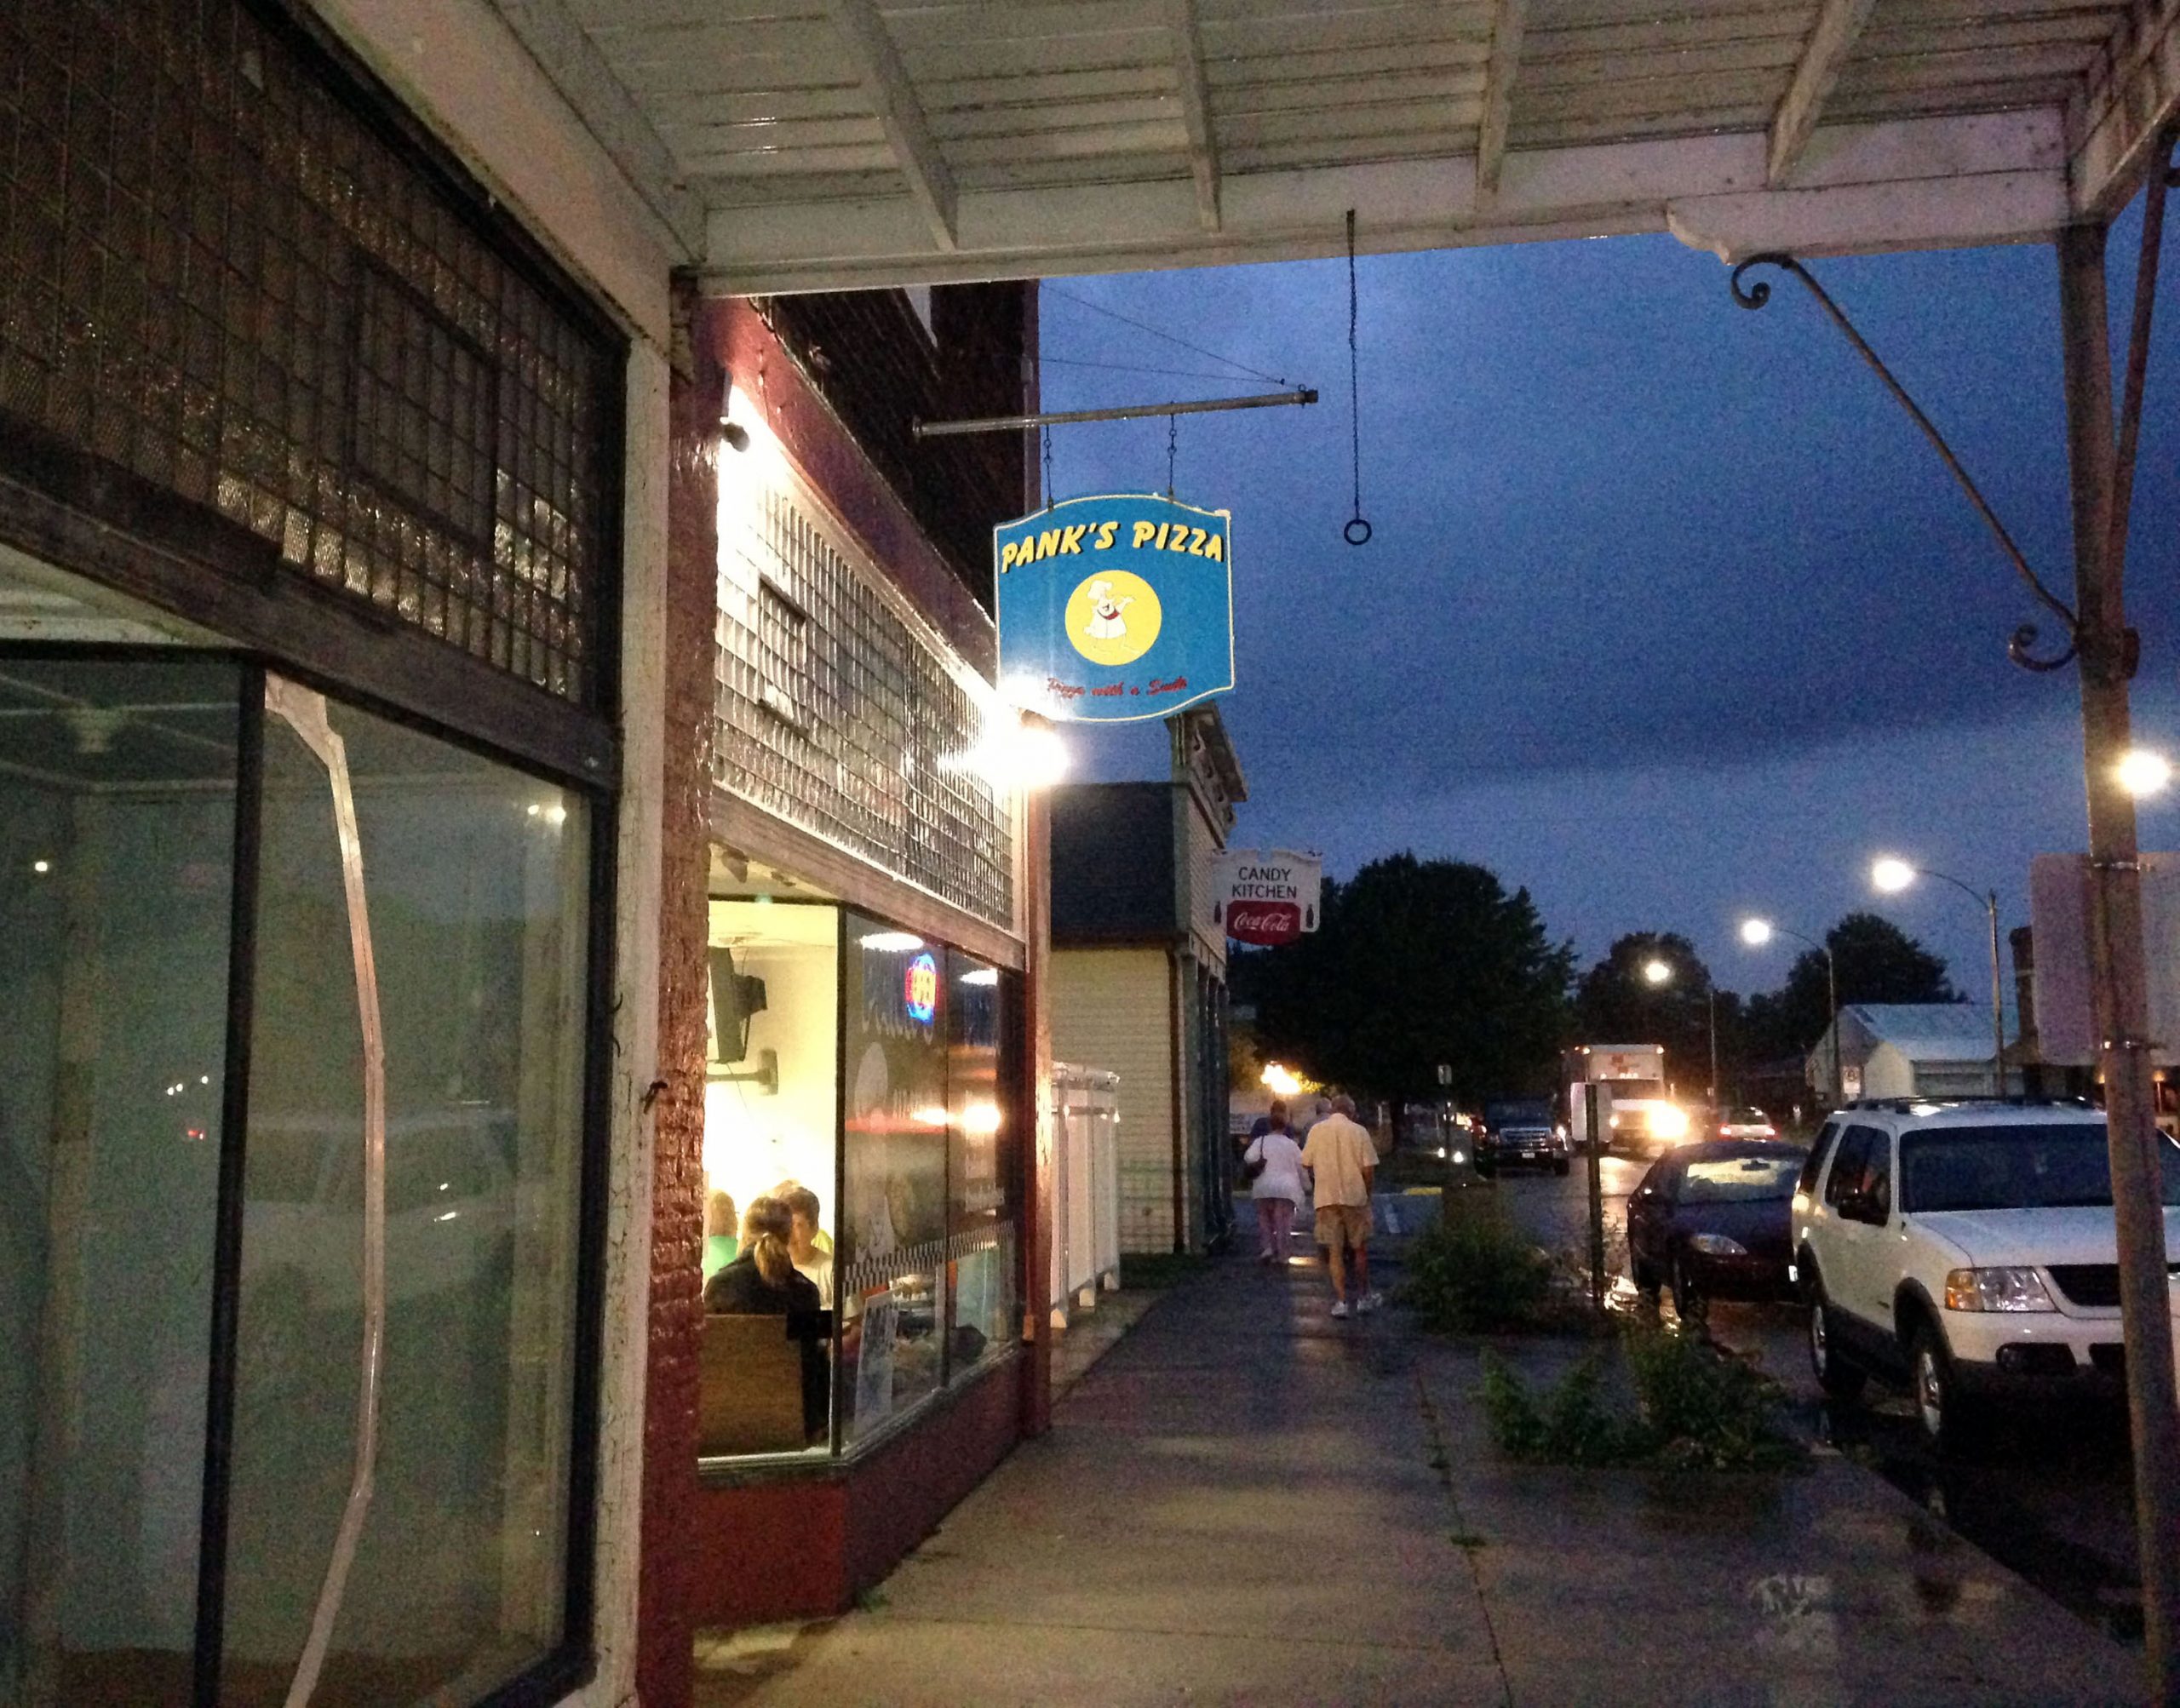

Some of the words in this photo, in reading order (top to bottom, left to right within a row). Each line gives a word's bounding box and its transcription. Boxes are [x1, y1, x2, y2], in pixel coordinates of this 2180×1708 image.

[1001, 520, 1120, 574] PANK'S
[1133, 520, 1224, 563] PIZZA
[1238, 867, 1291, 881] CANDY
[1231, 884, 1297, 898] KITCHEN
